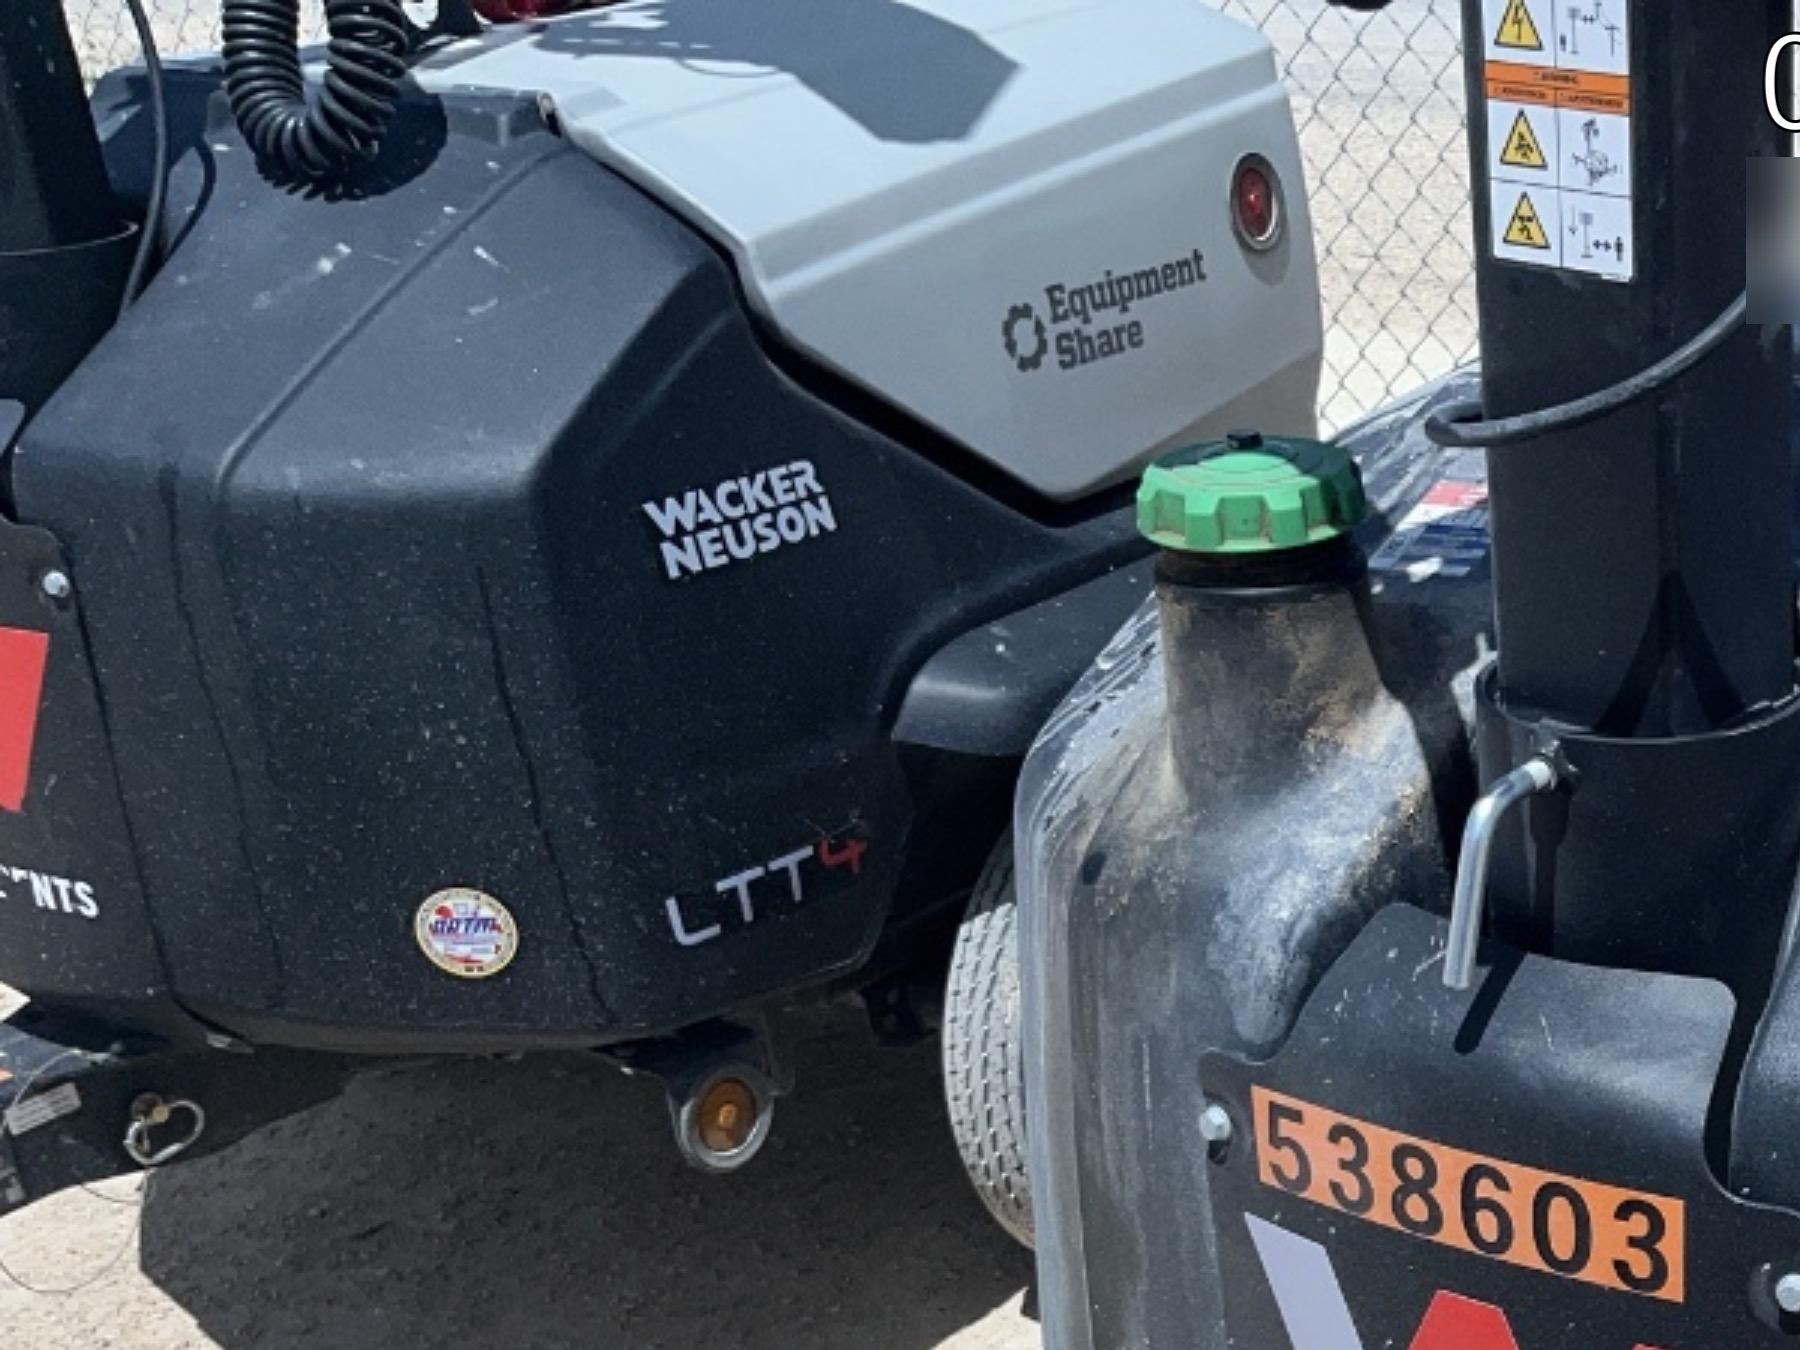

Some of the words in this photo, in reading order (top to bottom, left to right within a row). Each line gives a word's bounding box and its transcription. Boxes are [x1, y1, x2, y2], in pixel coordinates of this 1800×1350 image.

[1045, 248, 1206, 324] Equipment
[1055, 320, 1144, 370] Share
[641, 459, 825, 537] WACKER
[659, 495, 838, 581] NEUSON
[0, 863, 99, 918] NTS
[664, 838, 868, 946] LTT4
[1265, 1100, 1669, 1294] 538603
